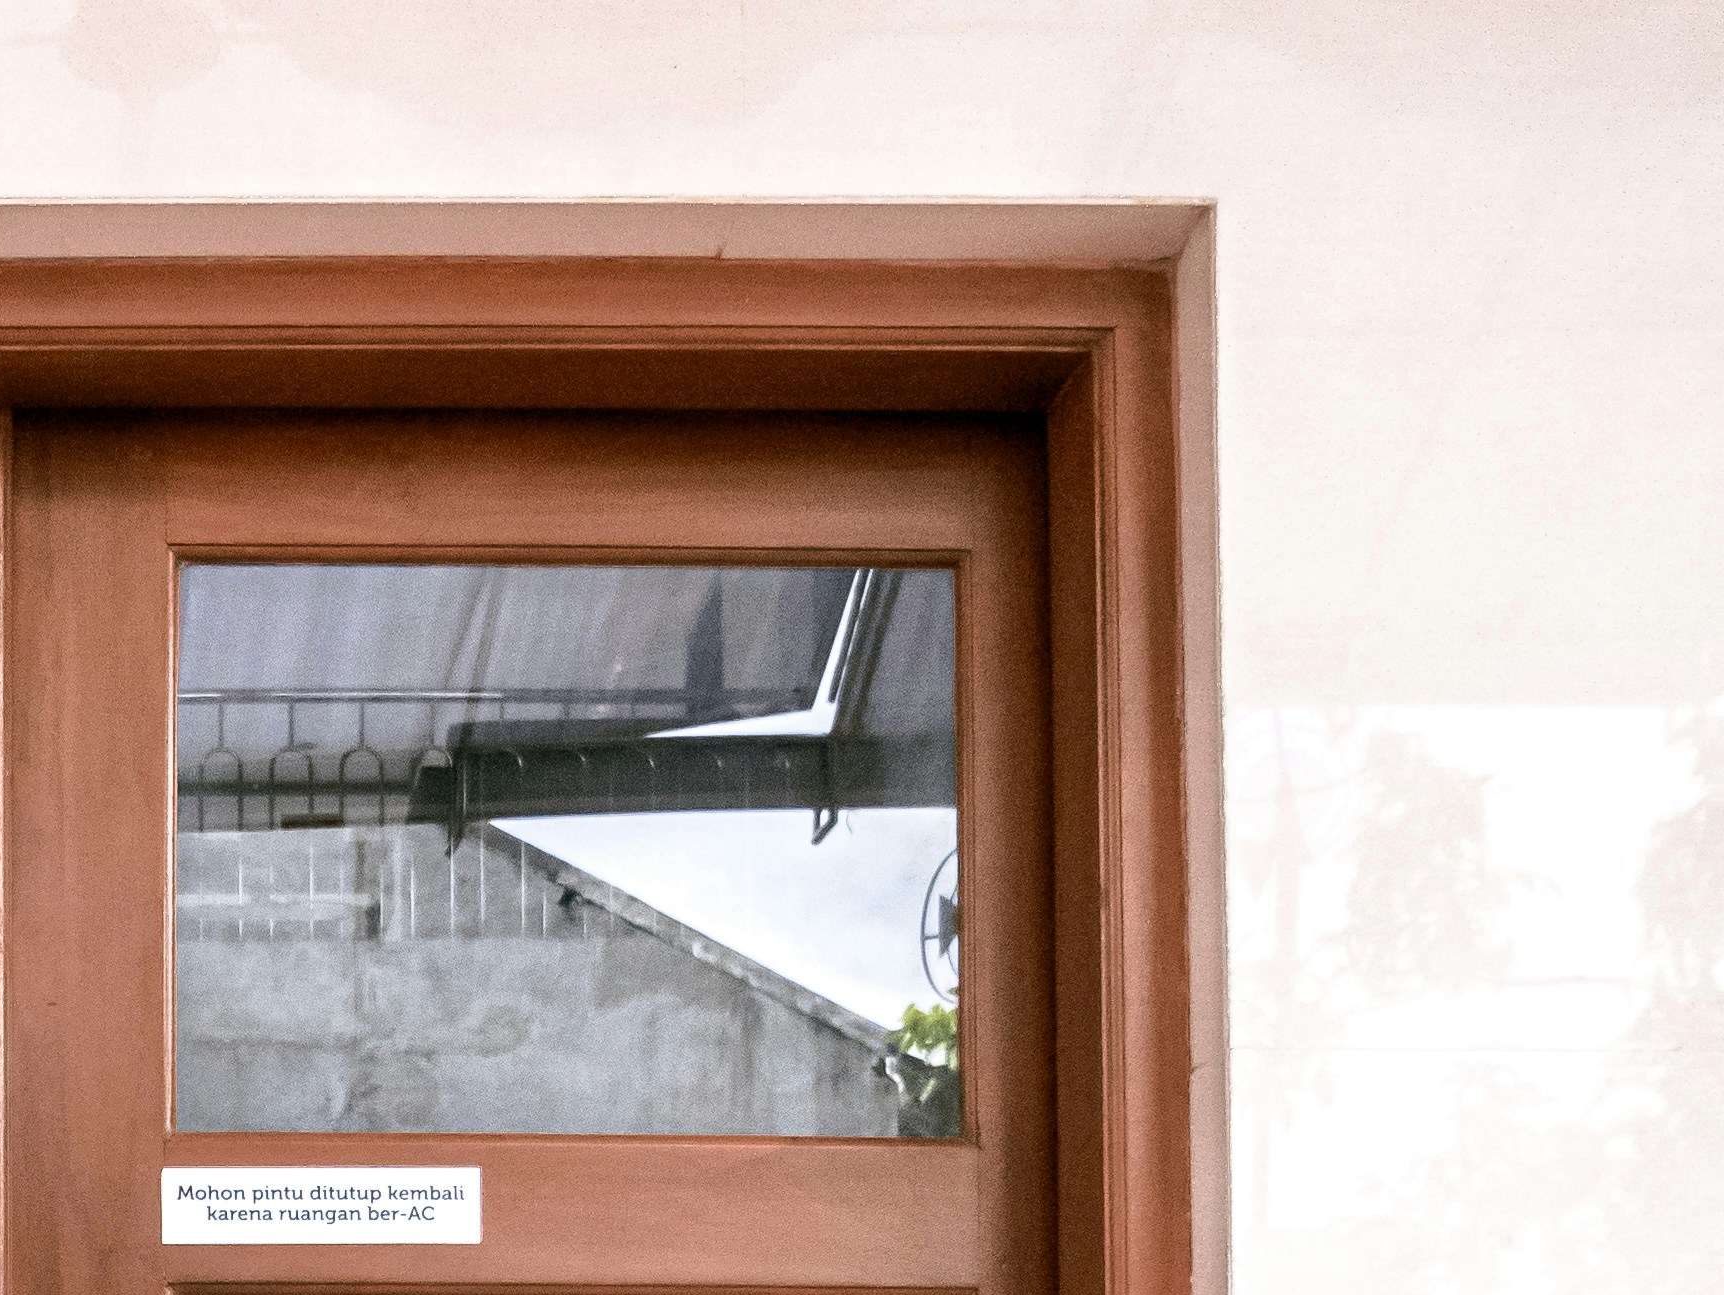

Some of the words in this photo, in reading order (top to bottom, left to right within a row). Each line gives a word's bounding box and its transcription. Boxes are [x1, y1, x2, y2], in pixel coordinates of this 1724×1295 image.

[177, 1185, 246, 1201] Mohon
[252, 1186, 303, 1204] pintu
[310, 1185, 382, 1204] ditutup
[388, 1186, 465, 1201] kembali
[207, 1206, 273, 1221] karena
[279, 1208, 361, 1224] ruangan
[368, 1206, 435, 1221] ber-AC
